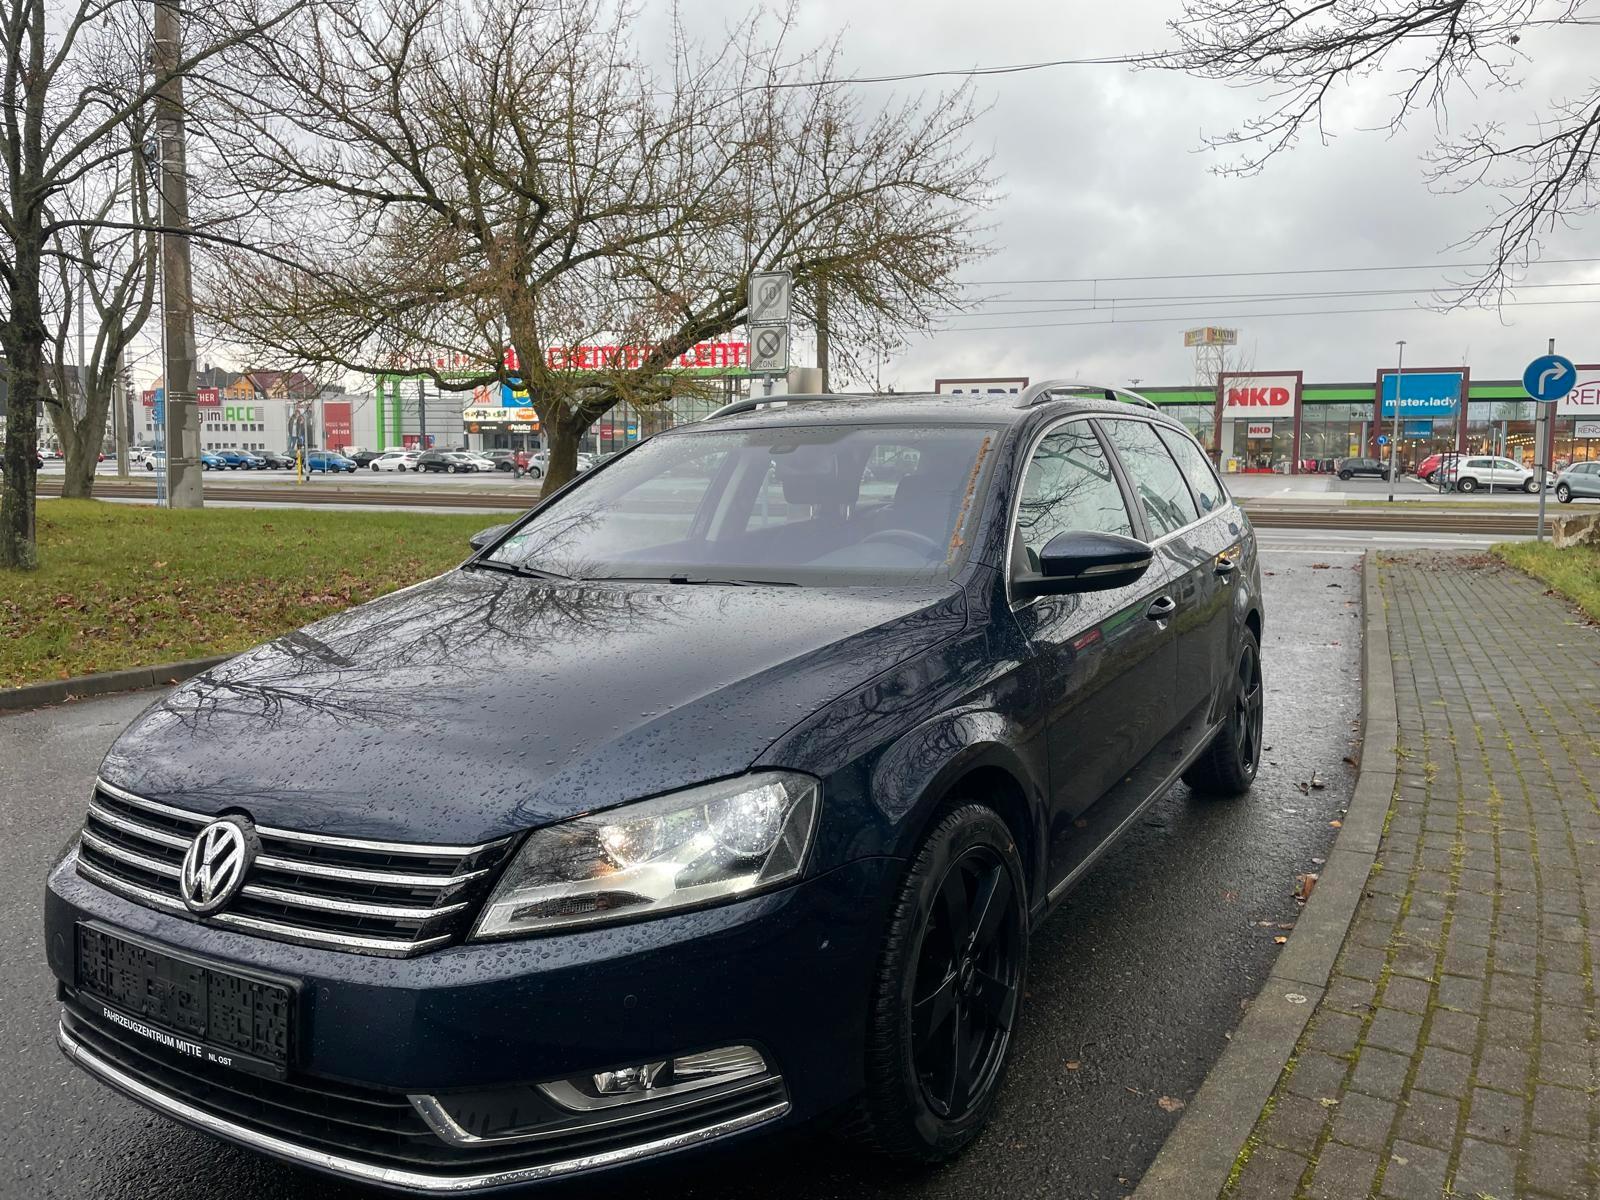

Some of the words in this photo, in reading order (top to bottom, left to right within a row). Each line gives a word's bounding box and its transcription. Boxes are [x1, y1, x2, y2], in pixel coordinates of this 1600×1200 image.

[758, 360, 778, 369] ZONE
[1228, 387, 1290, 407] NKD
[207, 408, 220, 421] im
[226, 406, 254, 421] ACC
[1249, 426, 1271, 434] NKD
[103, 1007, 175, 1048] FAHRZEUGZENTRUM
[175, 1038, 202, 1058] MITTE
[208, 1052, 217, 1063] NL
[218, 1056, 232, 1067] OST
